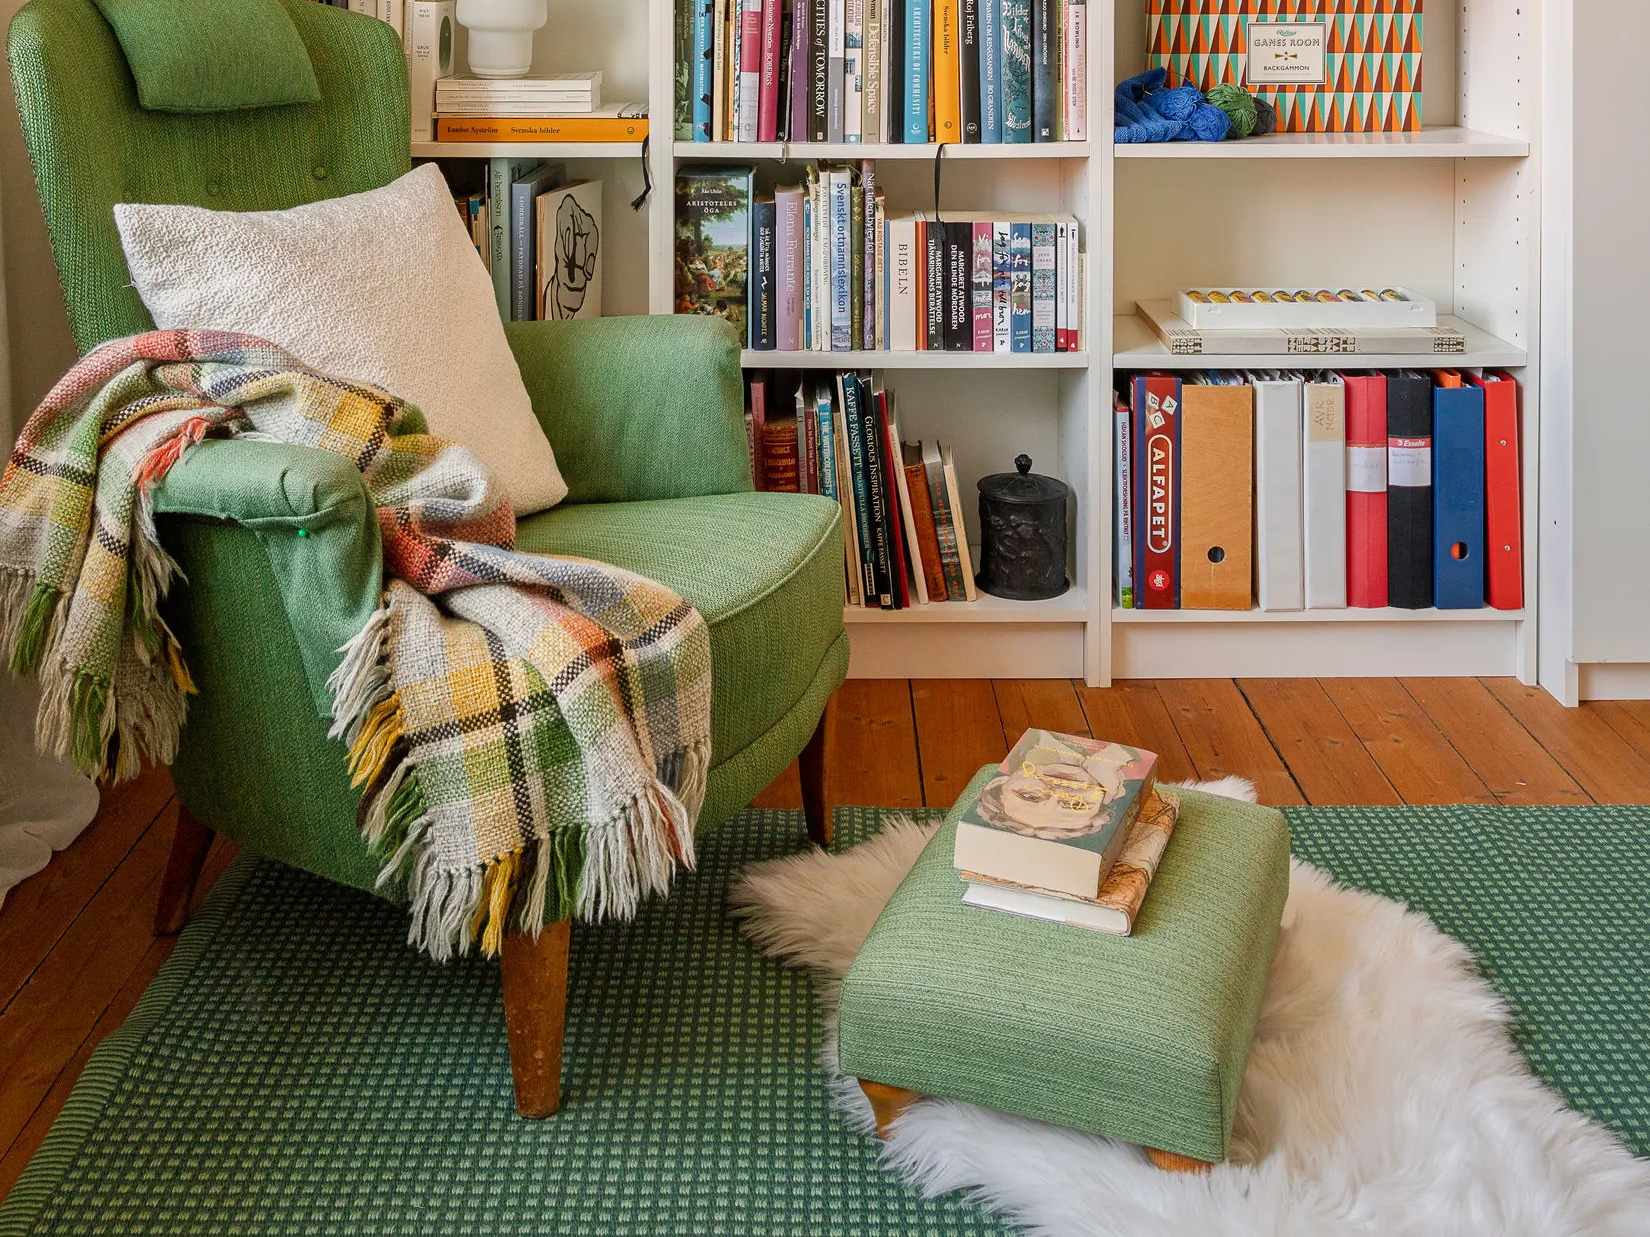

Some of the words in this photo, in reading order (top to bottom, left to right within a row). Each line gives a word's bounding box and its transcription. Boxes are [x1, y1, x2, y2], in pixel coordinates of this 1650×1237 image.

[965, 0, 974, 12] Roj
[765, 23, 775, 48] Nyström
[814, 38, 825, 47] of
[912, 6, 922, 60] ARCHITECTURE
[965, 15, 974, 45] Friberg
[986, 25, 993, 36] OM
[1253, 38, 1287, 47] GAMES
[1290, 38, 1320, 47] ROOM
[868, 23, 880, 80] Defensible
[942, 34, 950, 55] bilder
[765, 52, 773, 86] BOBERGS
[913, 63, 921, 72] OF
[986, 36, 995, 81] RENÄSSANSEN
[1076, 54, 1085, 84] HARRY
[815, 50, 825, 117] TOMORROW
[912, 74, 921, 115] COMMUNITY
[987, 84, 994, 95] BO
[864, 81, 878, 114] Space
[1076, 86, 1084, 120] POTTER
[471, 126, 498, 134] Nyström
[510, 126, 538, 134] Svenska
[539, 126, 561, 134] bilder
[867, 172, 875, 191] När
[836, 182, 847, 224] Svenskt
[867, 192, 875, 215] tiden
[786, 201, 798, 236] Elena
[865, 217, 875, 239] byter
[867, 241, 875, 254] fot
[950, 244, 958, 260] DEN
[786, 239, 797, 292] Ferrante
[837, 226, 848, 313] ortnamnslexikon
[898, 243, 908, 295] BIBELN
[928, 238, 936, 292] TJÄNARINNANS
[950, 261, 958, 287] BLINDE
[1012, 255, 1030, 268] for
[999, 290, 1008, 303] till
[1012, 281, 1031, 293] jag
[928, 293, 937, 335] BERÄTTELSE
[950, 288, 959, 329] MÖRDAREN
[998, 305, 1008, 326] bror
[1012, 303, 1031, 315] hem
[846, 386, 858, 422] KAFFE
[1150, 396, 1159, 405] B
[1164, 400, 1175, 409] A
[822, 421, 830, 435] THE
[1153, 415, 1163, 425] C
[849, 423, 863, 468] FASSETT
[865, 416, 876, 463] GLORIOUS
[823, 435, 832, 495] WATERCOLORIST'S
[869, 464, 881, 522] INSPIRATION
[1151, 447, 1167, 538] ALFAPET
[856, 471, 866, 512] PRAKTFULLA
[861, 512, 871, 549] BRODERIER
[878, 548, 886, 574] FASSETT
[1154, 573, 1165, 587] alga
[1116, 760, 1134, 768] DEN
